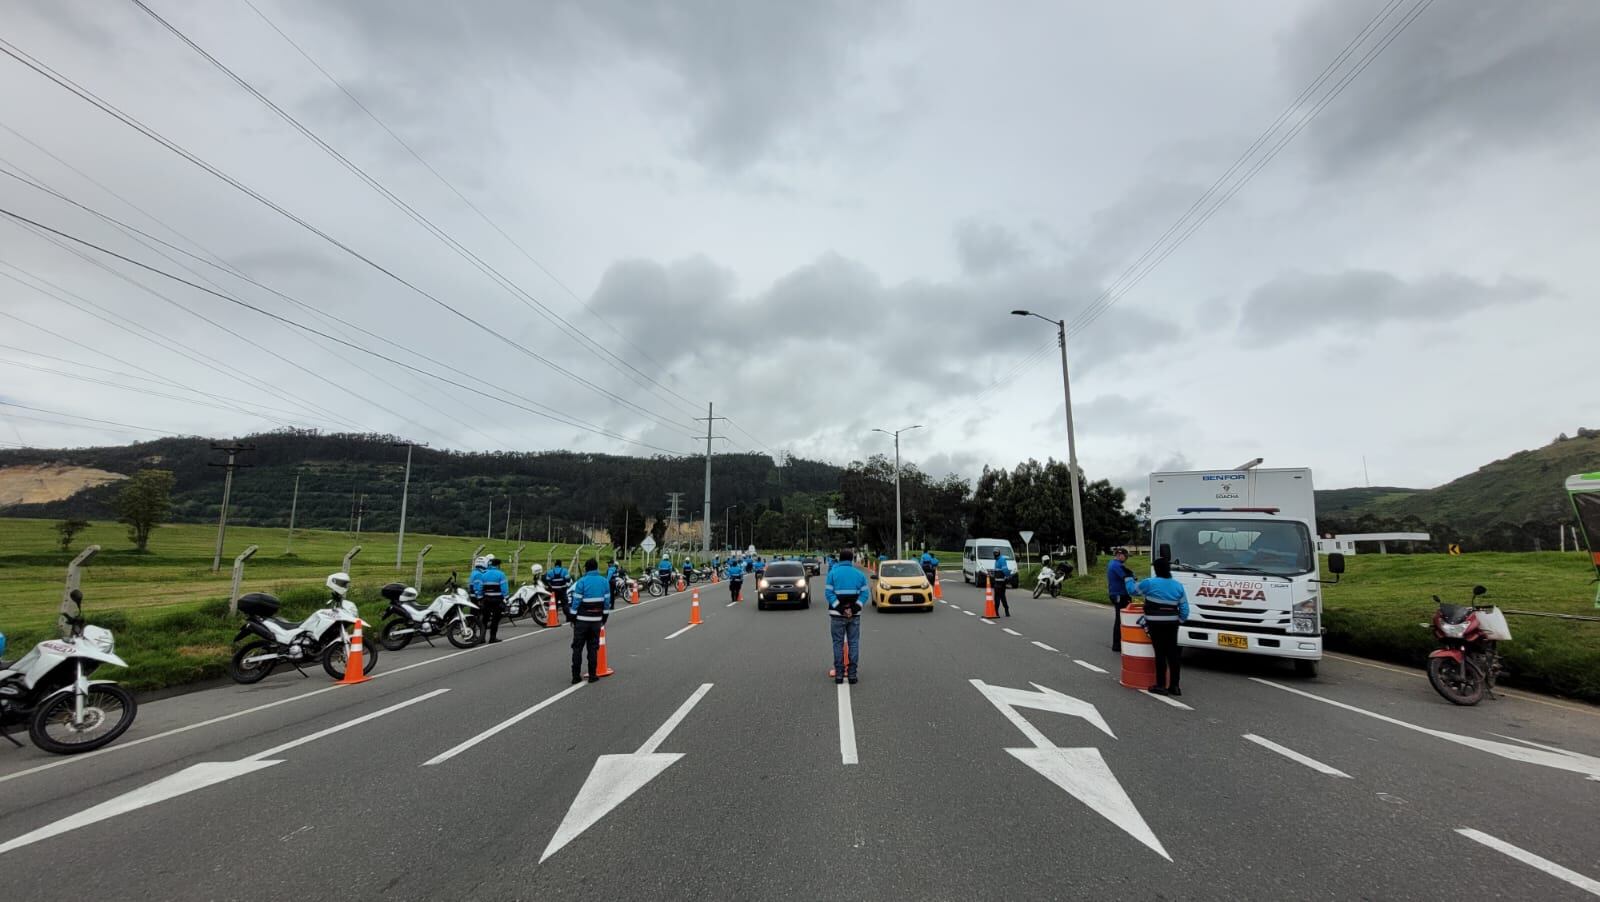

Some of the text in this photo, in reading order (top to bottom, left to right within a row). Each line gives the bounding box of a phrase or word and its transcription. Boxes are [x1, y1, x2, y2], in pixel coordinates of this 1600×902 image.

[1201, 579, 1214, 587] EL
[1218, 580, 1263, 590] CAMBIO
[1195, 586, 1267, 602] AVANZA
